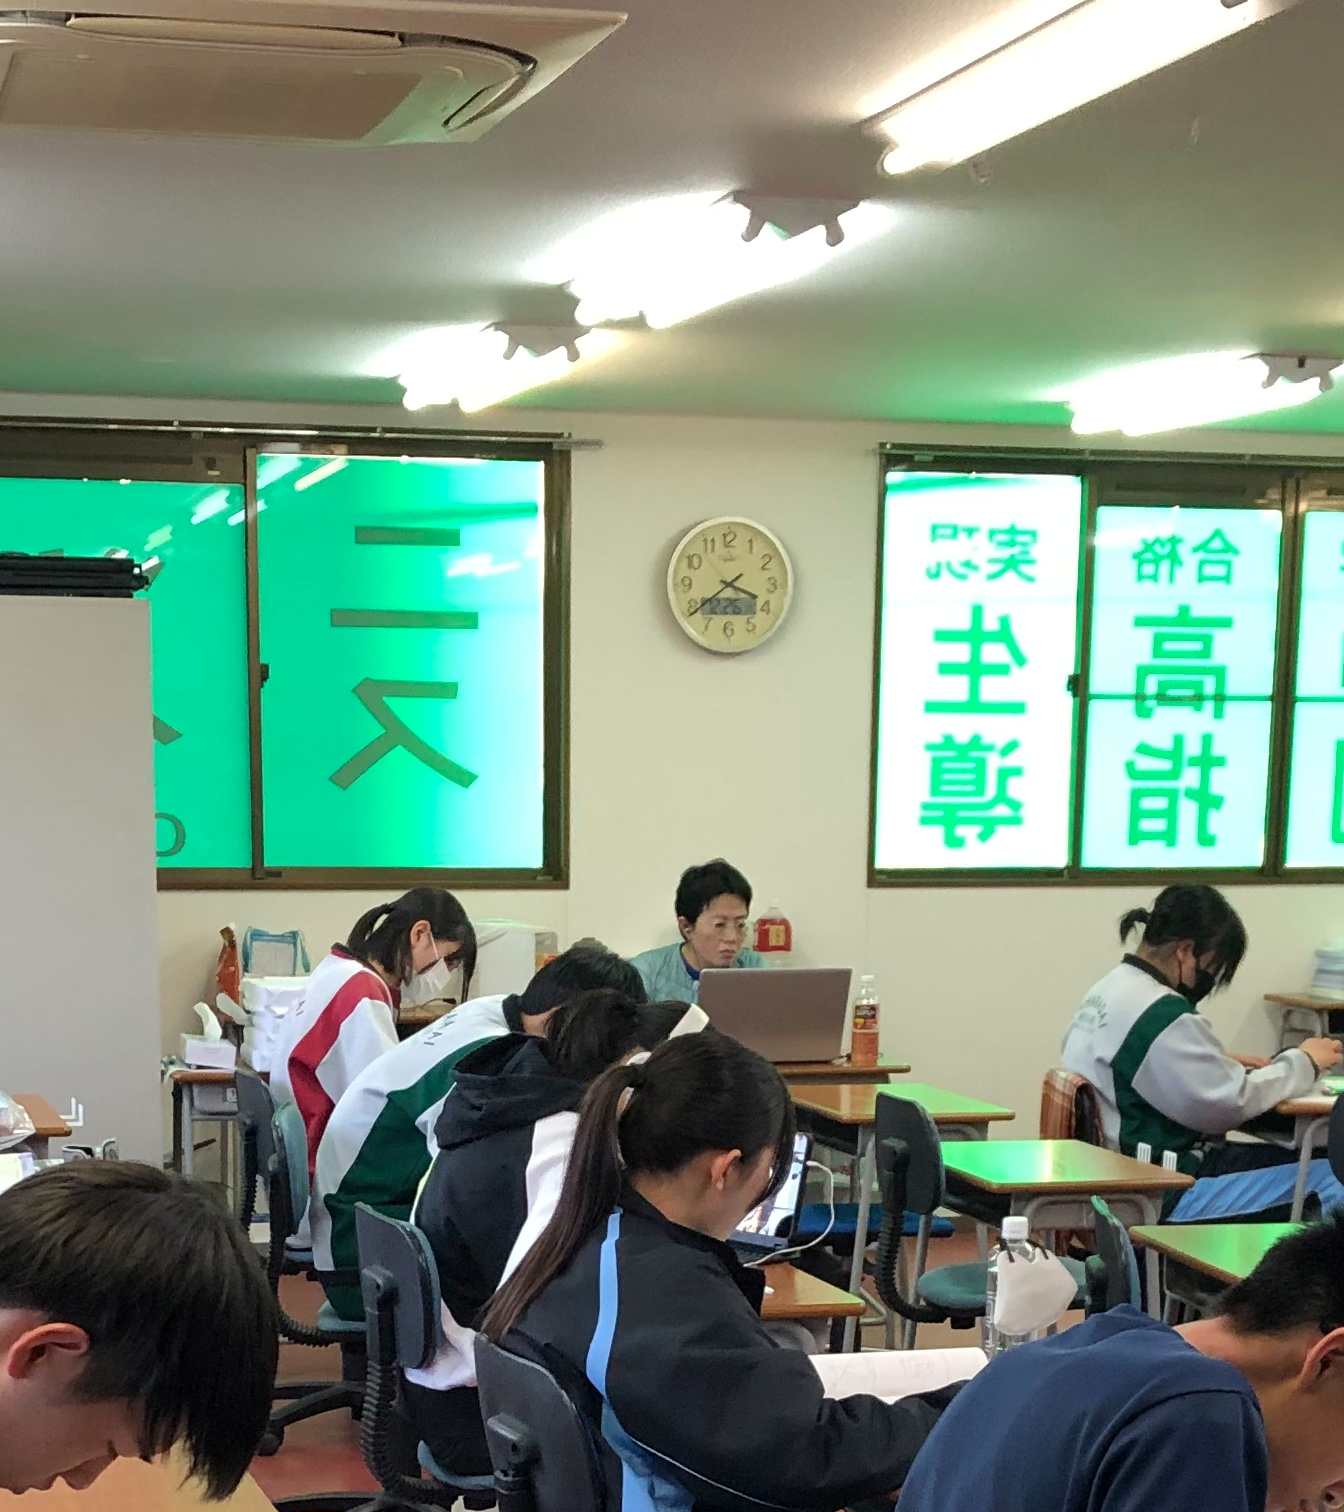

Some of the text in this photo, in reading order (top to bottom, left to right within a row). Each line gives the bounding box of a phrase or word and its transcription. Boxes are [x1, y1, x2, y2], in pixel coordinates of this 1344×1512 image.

[703, 538, 715, 553] 11
[722, 532, 737, 547] 12
[747, 538, 754, 553] 1
[687, 553, 702, 570] 10
[760, 554, 772, 570] 2
[681, 576, 692, 592] 9
[767, 577, 777, 593] 3
[760, 600, 771, 614] 4
[723, 621, 734, 637] 6
[746, 617, 756, 632] 5
